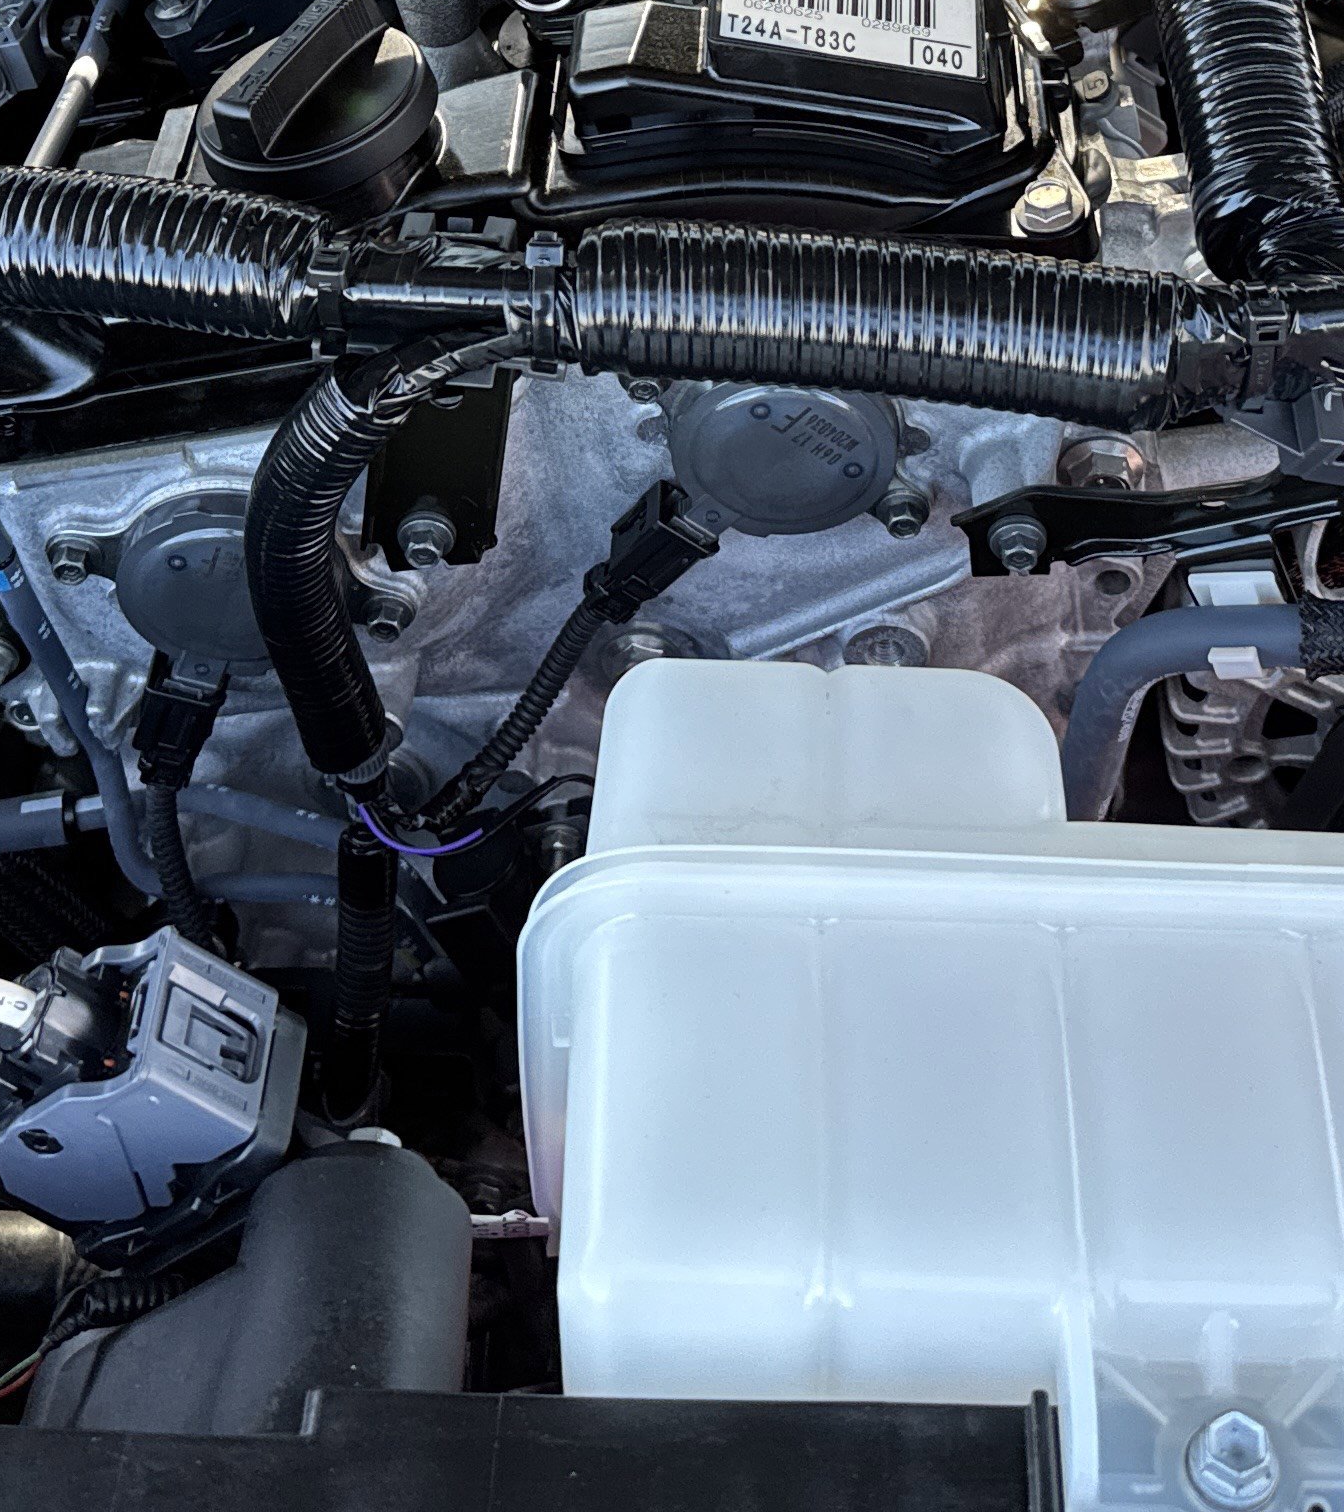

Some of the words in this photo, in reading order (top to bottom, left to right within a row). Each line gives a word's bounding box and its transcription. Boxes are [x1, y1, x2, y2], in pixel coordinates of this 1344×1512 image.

[727, 13, 856, 53] T24A-T83C
[922, 45, 963, 70] 040
[862, 18, 931, 37] 0289869
